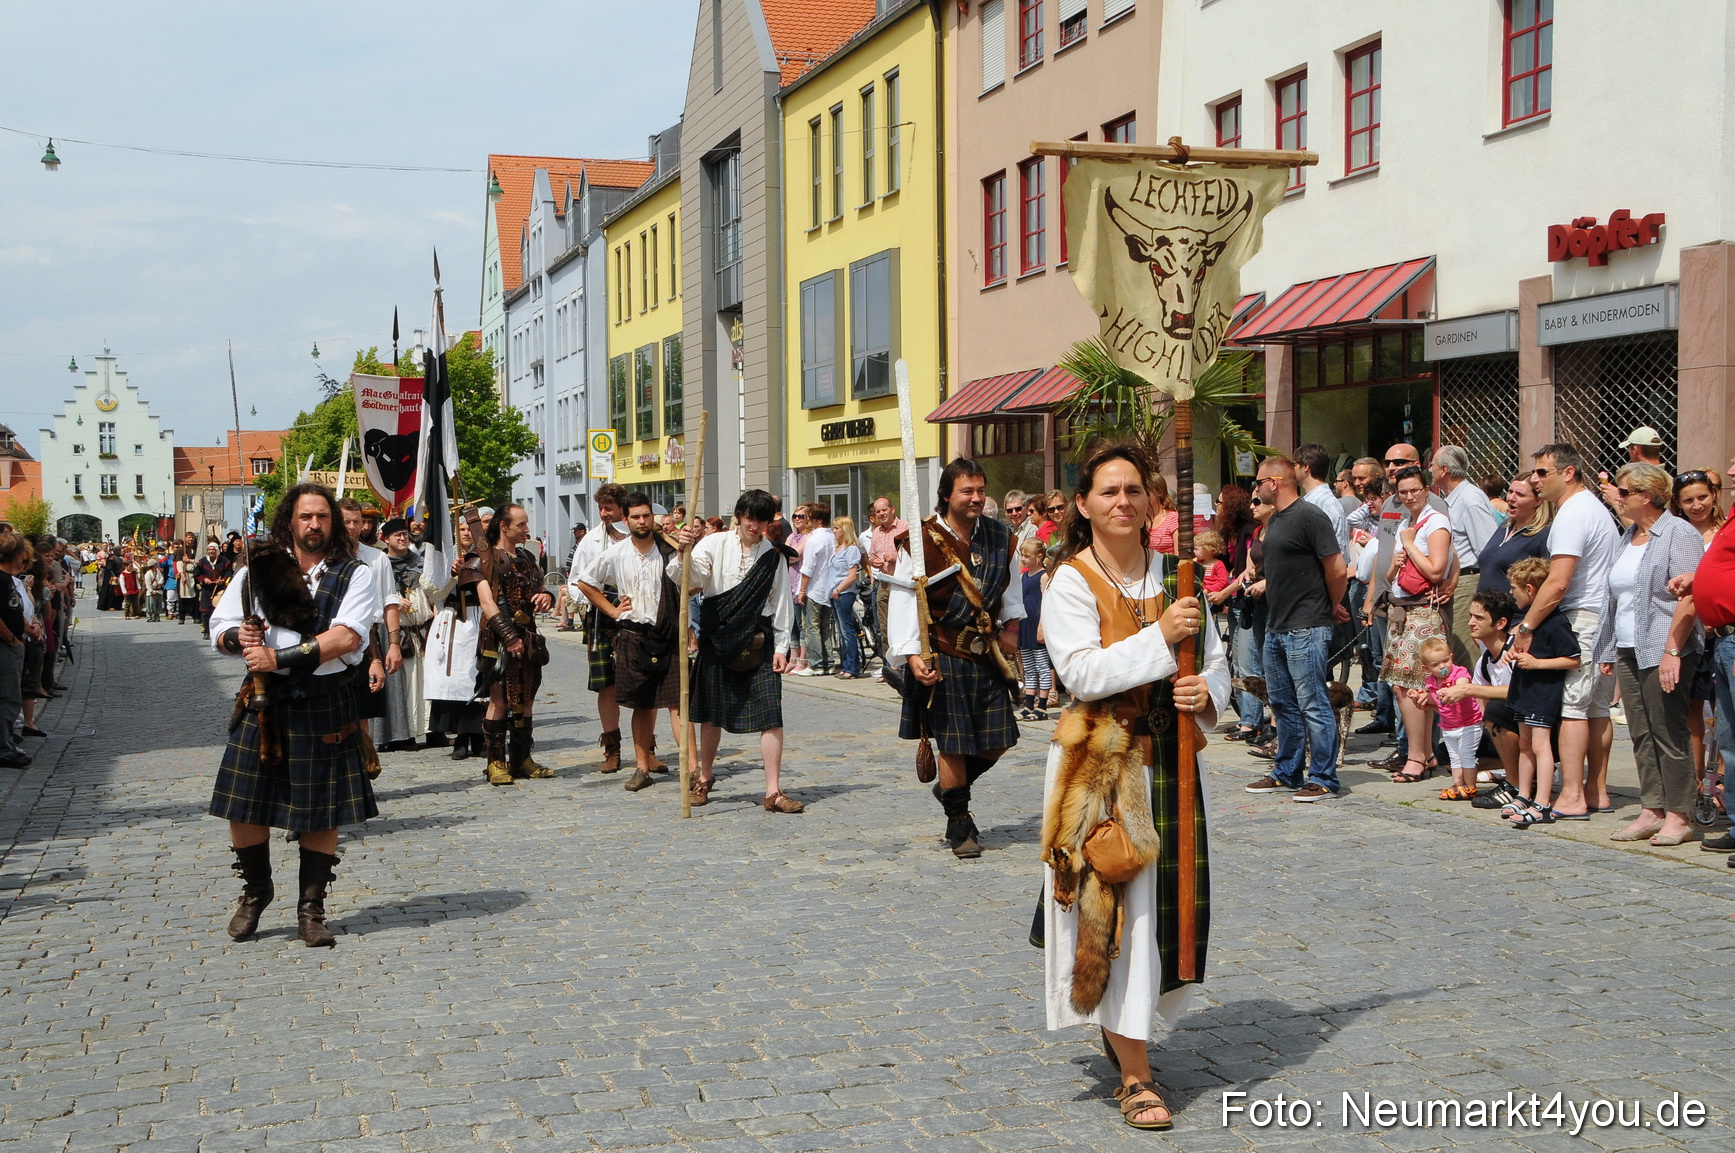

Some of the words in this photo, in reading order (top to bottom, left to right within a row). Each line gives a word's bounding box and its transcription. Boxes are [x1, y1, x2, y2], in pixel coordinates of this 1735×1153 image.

[1129, 170, 1239, 220] LECHFELD
[1548, 209, 1666, 266] Döpfer
[1544, 317, 1568, 331] BABY
[1570, 315, 1579, 326] &
[1581, 302, 1660, 325] KINDERMODEN
[1435, 330, 1478, 346] GARDINEN
